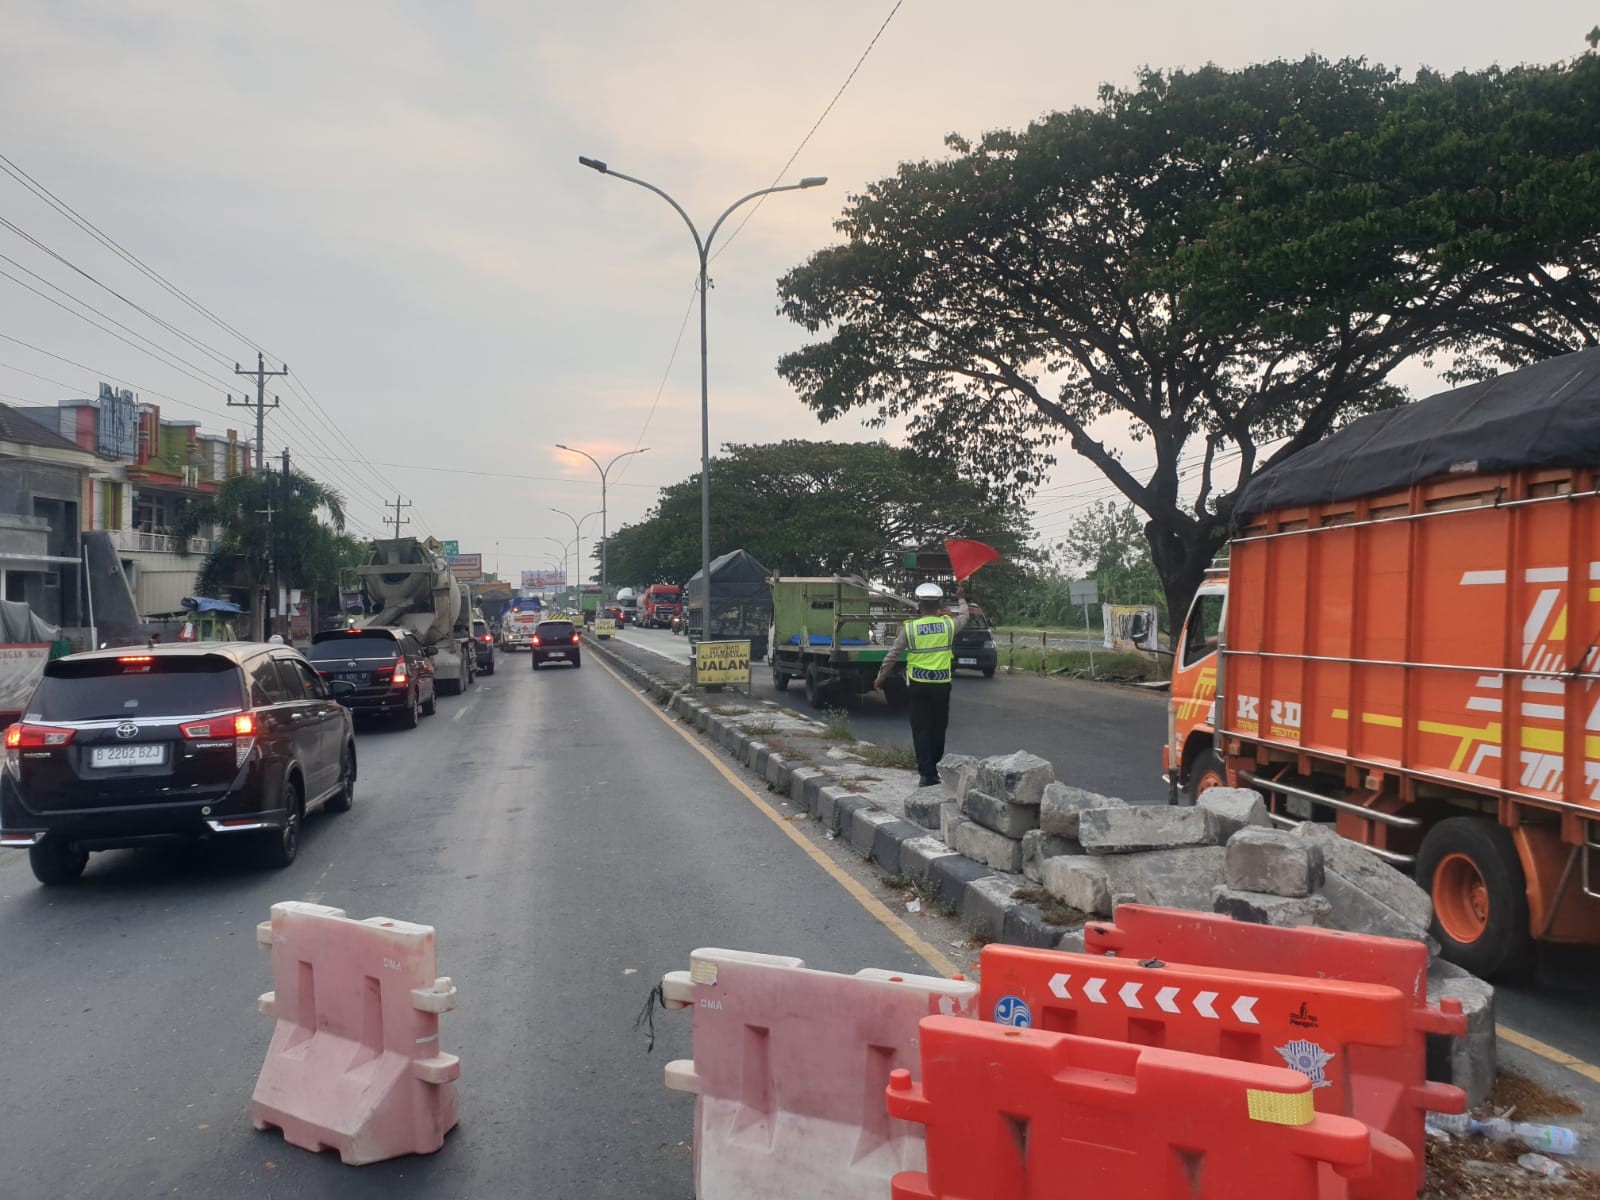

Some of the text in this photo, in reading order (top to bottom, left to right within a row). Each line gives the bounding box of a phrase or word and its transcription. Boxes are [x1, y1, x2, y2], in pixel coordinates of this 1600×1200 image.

[918, 623, 944, 634] POLISI
[698, 660, 749, 671] JALAN
[96, 745, 160, 760] B 2202 BZJ
